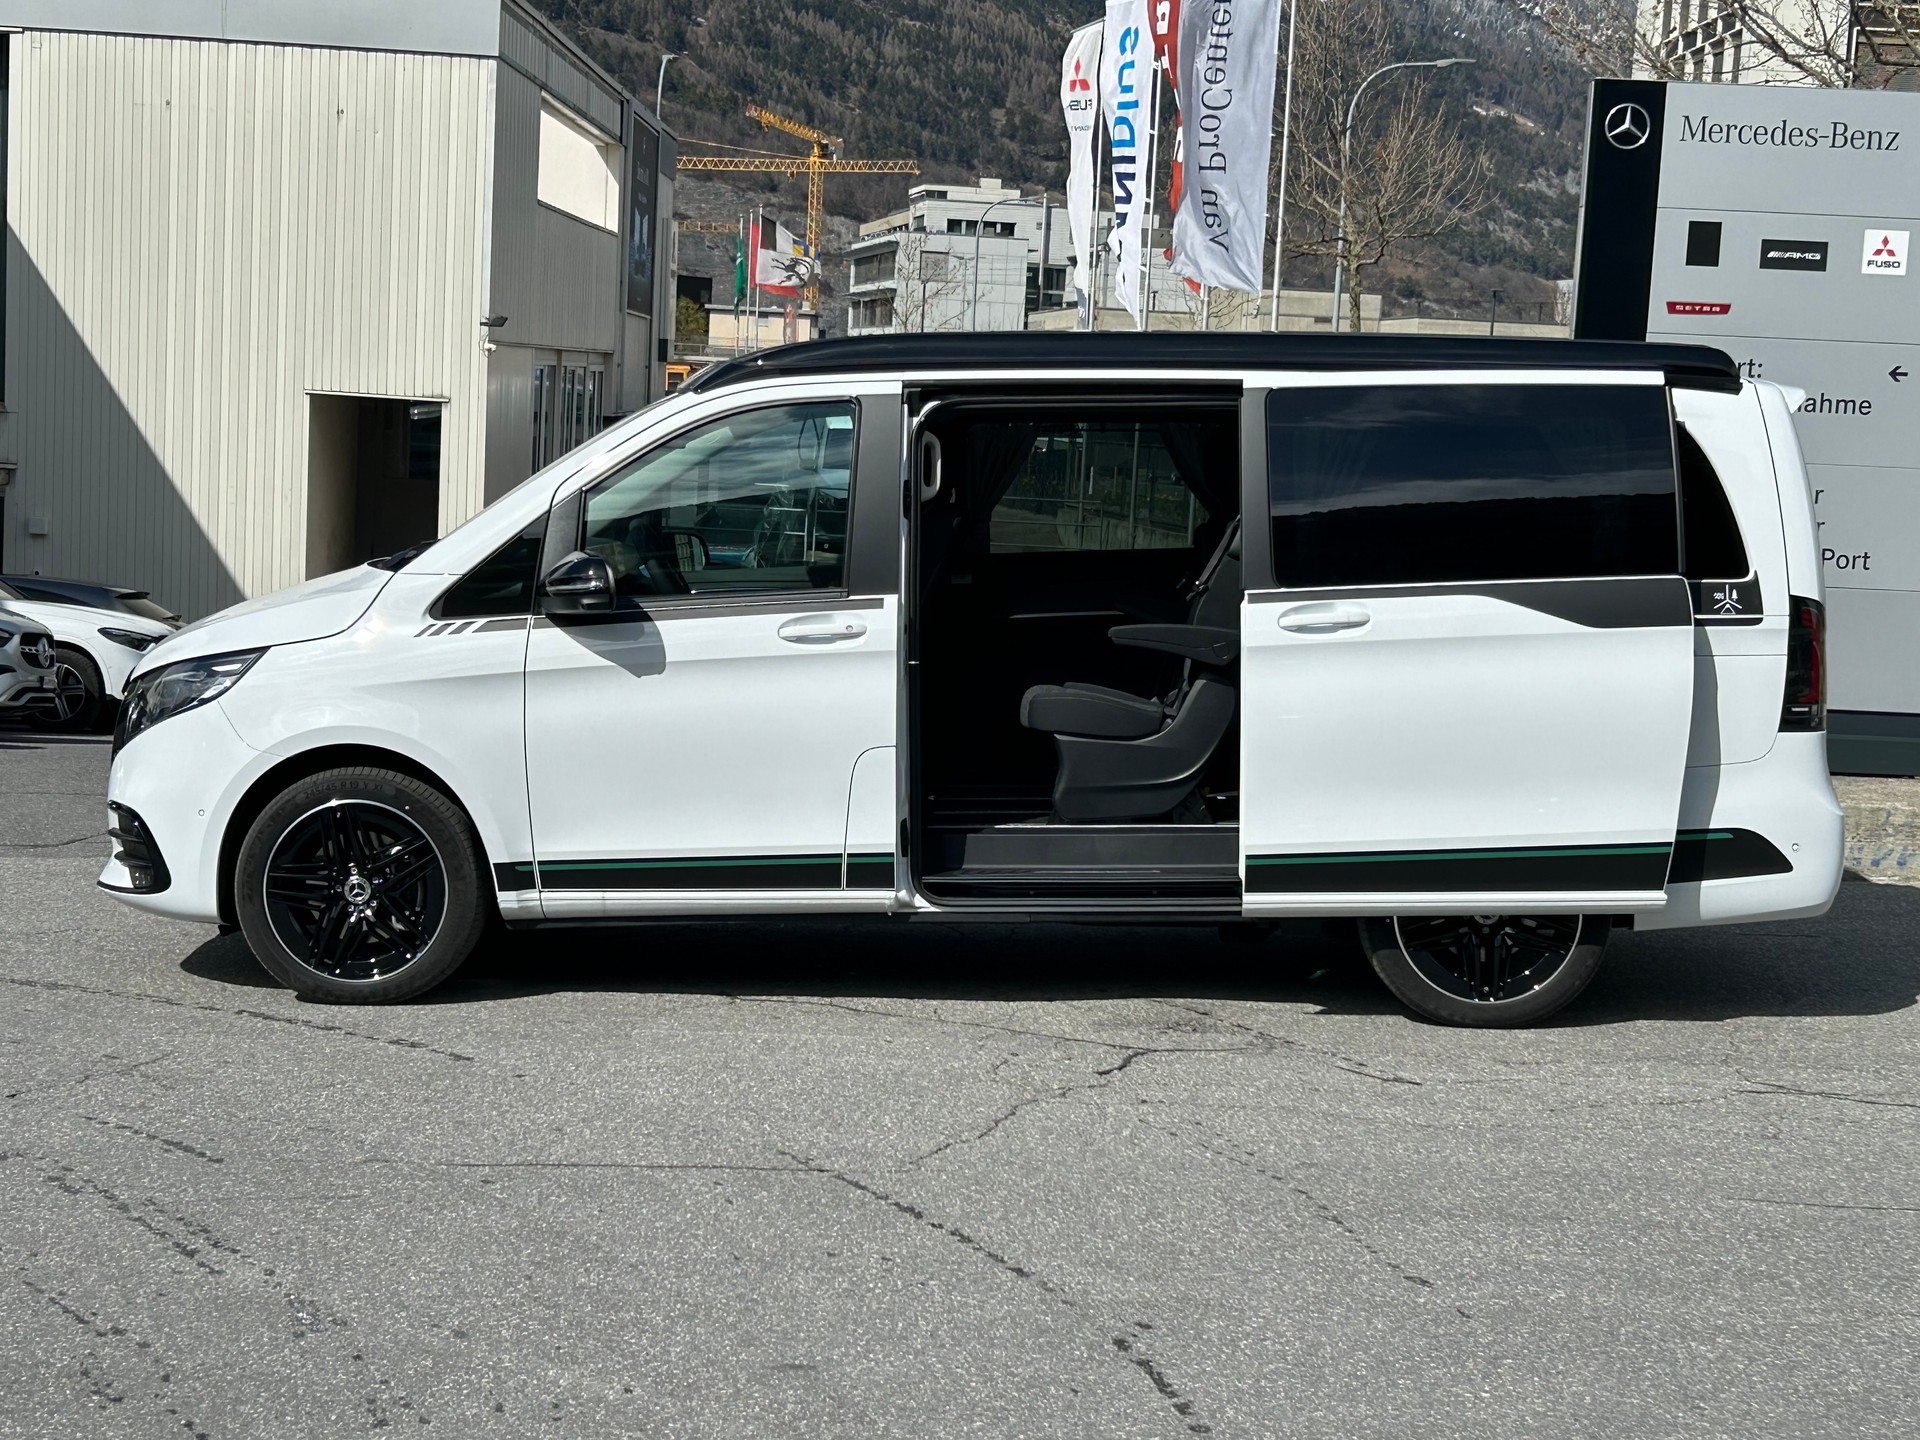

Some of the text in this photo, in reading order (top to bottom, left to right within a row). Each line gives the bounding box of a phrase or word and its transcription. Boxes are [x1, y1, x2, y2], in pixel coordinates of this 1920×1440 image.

[1679, 115, 1900, 151] Mercedes-Benz
[1784, 252, 1821, 260] AMG
[1867, 260, 1901, 269] FUSO
[1798, 392, 1872, 416] ahme
